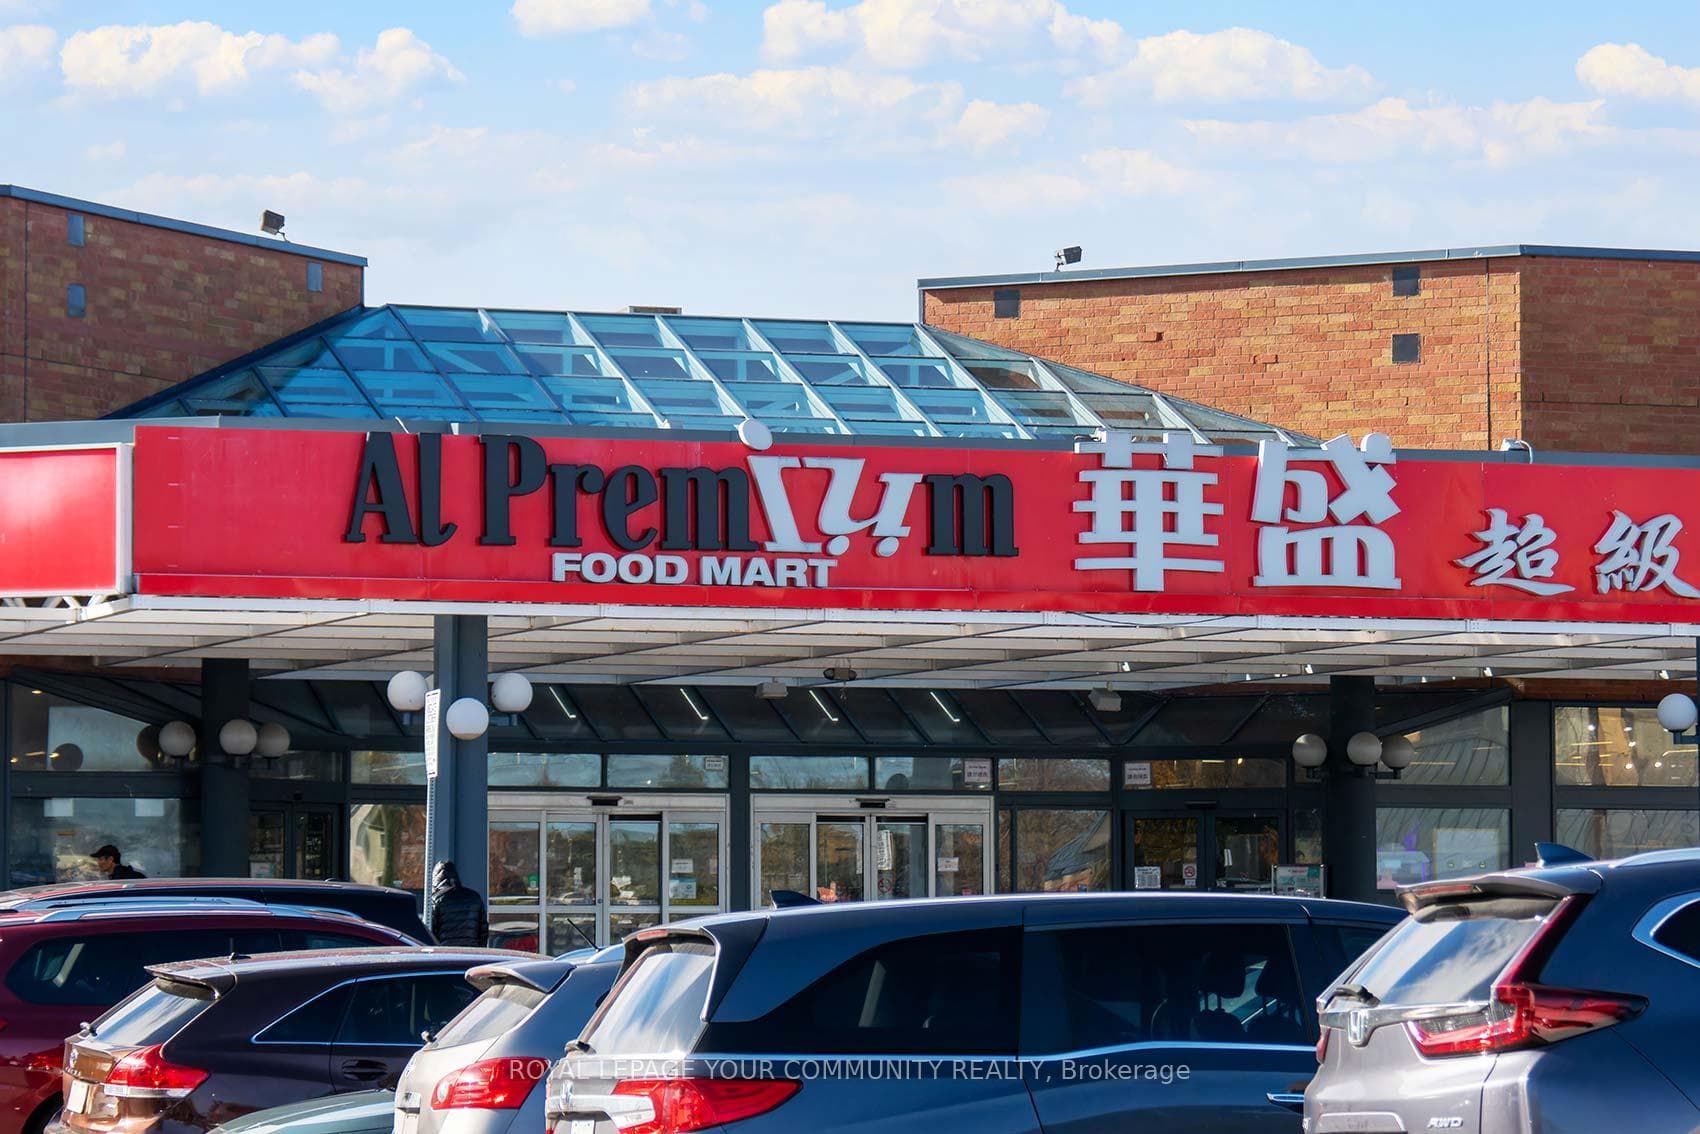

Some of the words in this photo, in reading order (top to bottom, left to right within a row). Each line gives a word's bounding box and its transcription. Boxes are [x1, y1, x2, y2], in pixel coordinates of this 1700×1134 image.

[344, 431, 458, 547] Al
[478, 419, 1019, 558] Premium
[1073, 430, 1402, 592] 華盛
[1456, 507, 1700, 599] 超級
[552, 552, 689, 585] FOOD
[702, 556, 838, 588] MART
[1427, 1117, 1464, 1129] AWD
